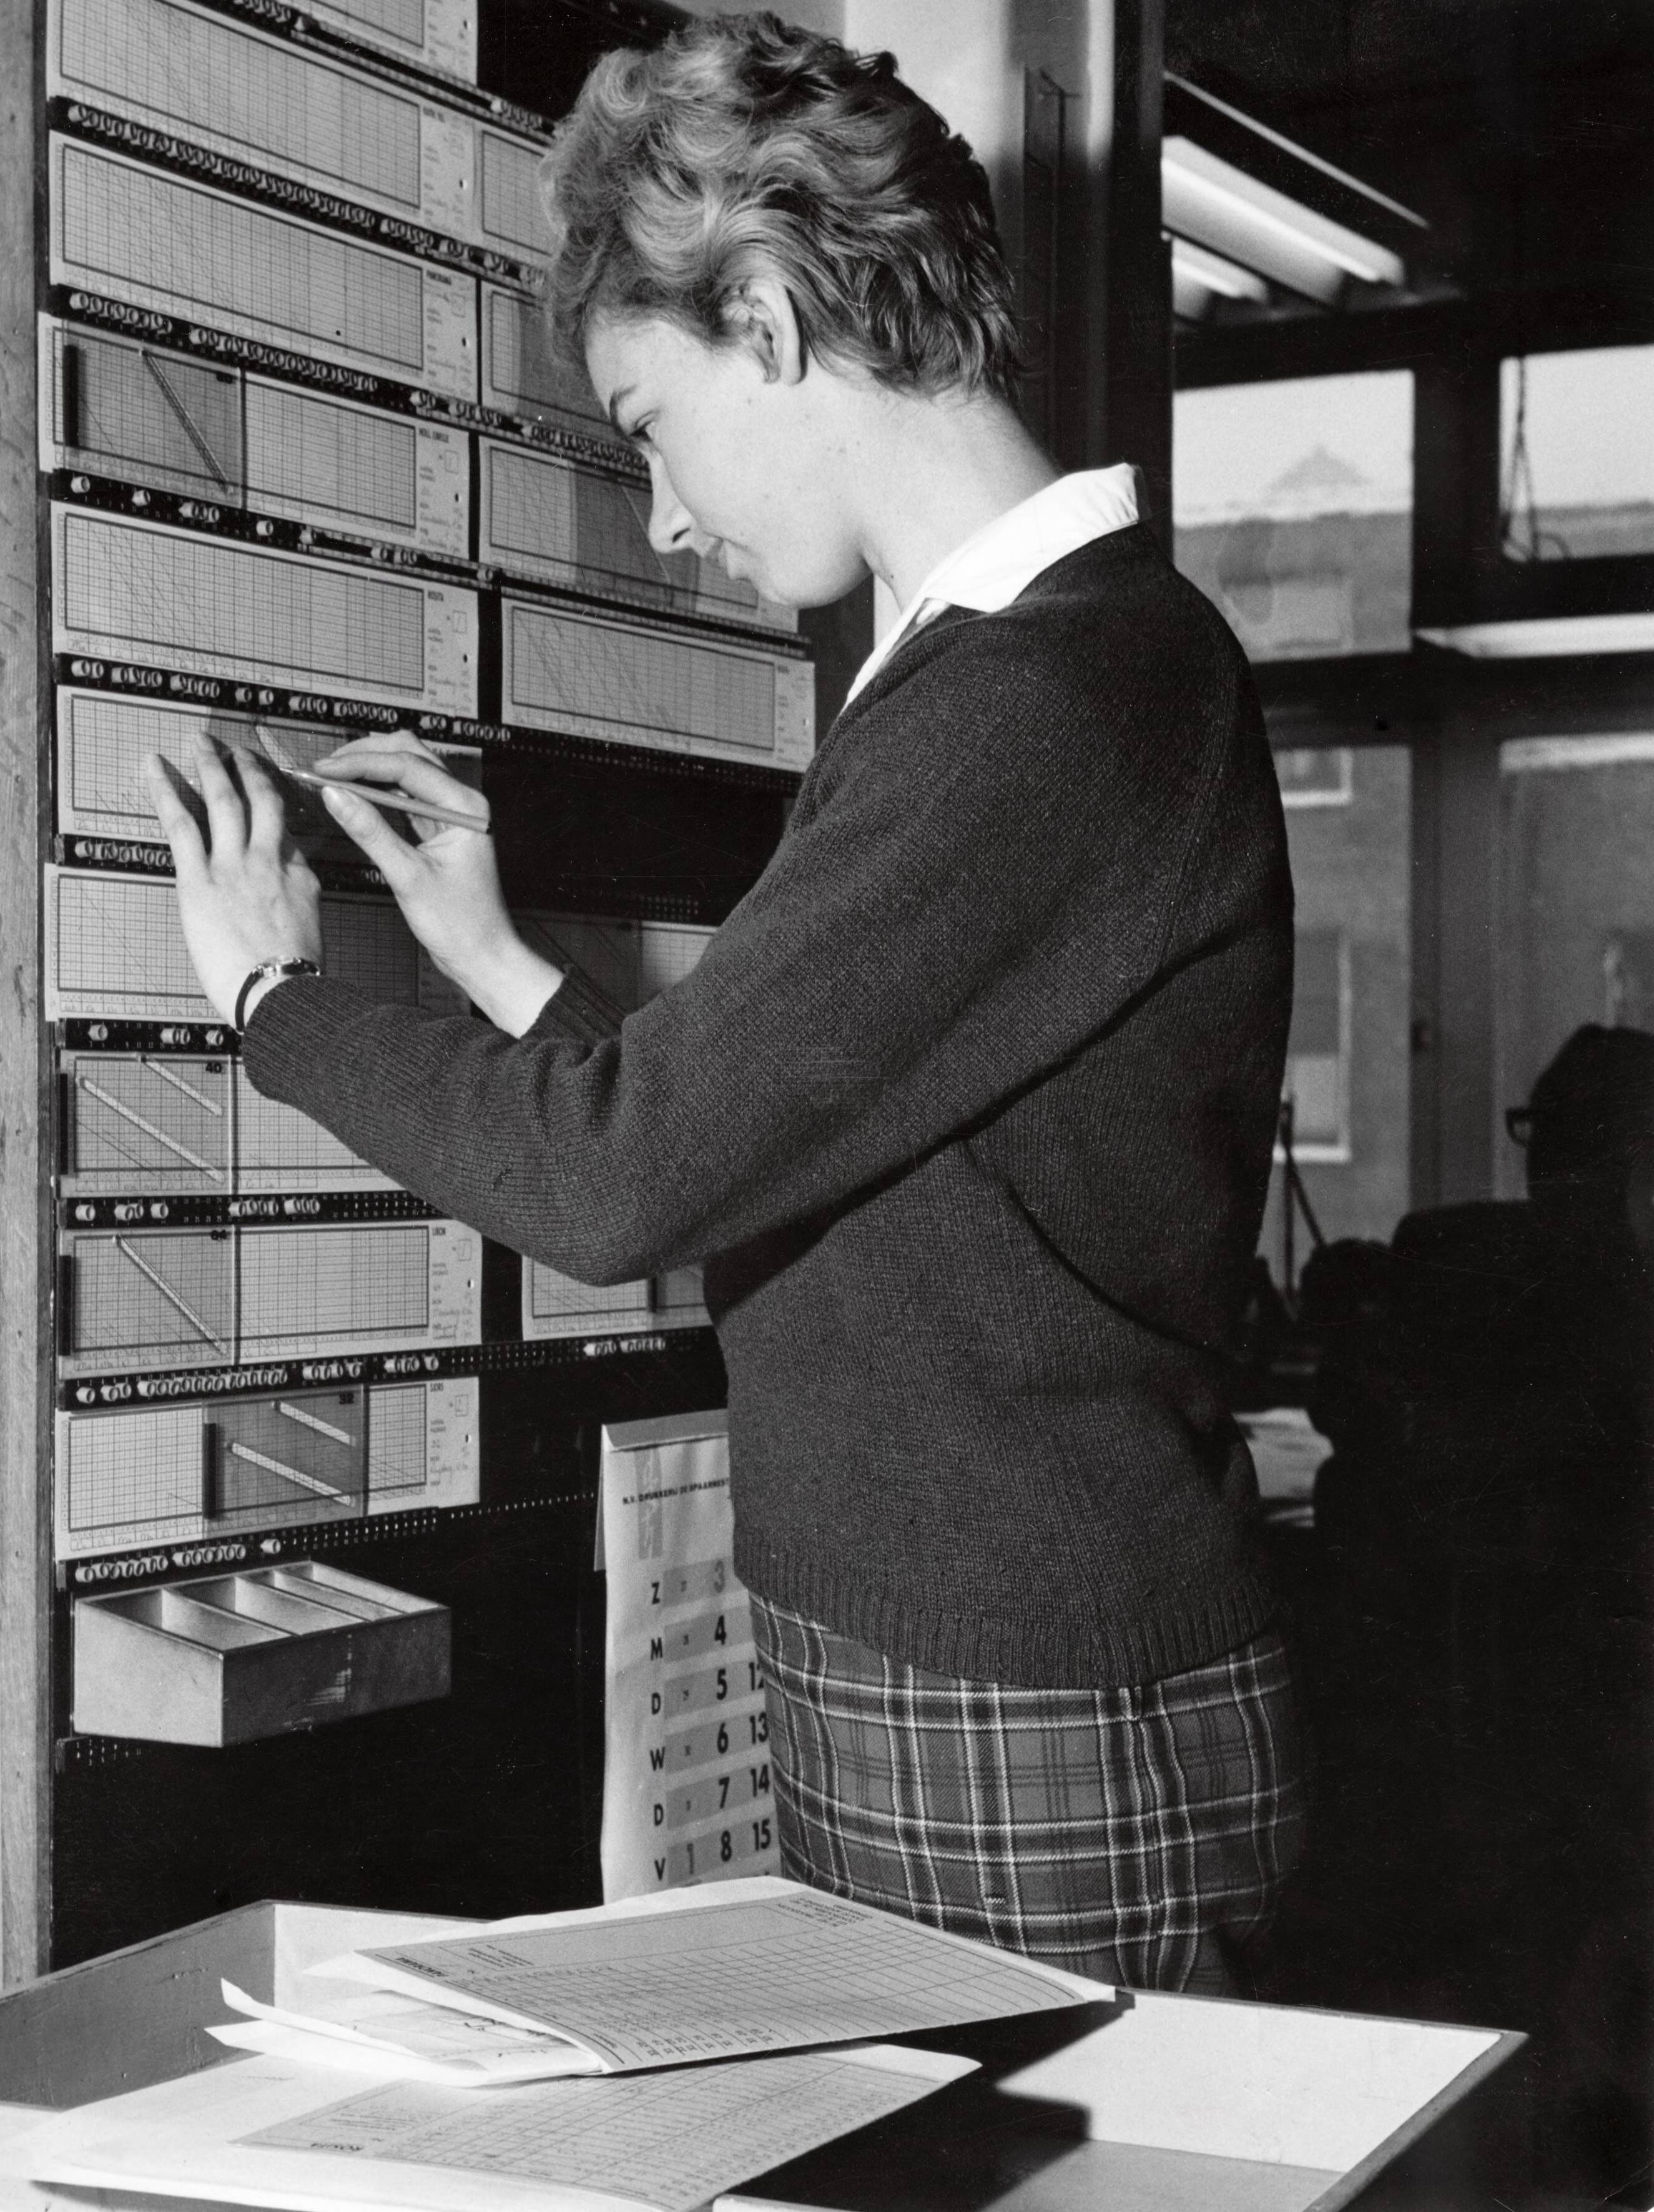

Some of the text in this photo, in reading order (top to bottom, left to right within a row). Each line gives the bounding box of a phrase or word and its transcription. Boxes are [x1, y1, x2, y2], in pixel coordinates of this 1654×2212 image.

[205, 1061, 222, 1073] 40
[651, 1560, 725, 1605] Z 3
[651, 1615, 727, 1661] M 4
[651, 1692, 661, 1715] D
[717, 1669, 727, 1700] 5
[650, 1712, 769, 1771] W 6 13
[654, 1764, 770, 1826] D 7 14
[654, 1818, 771, 1880] V 1 8 15
